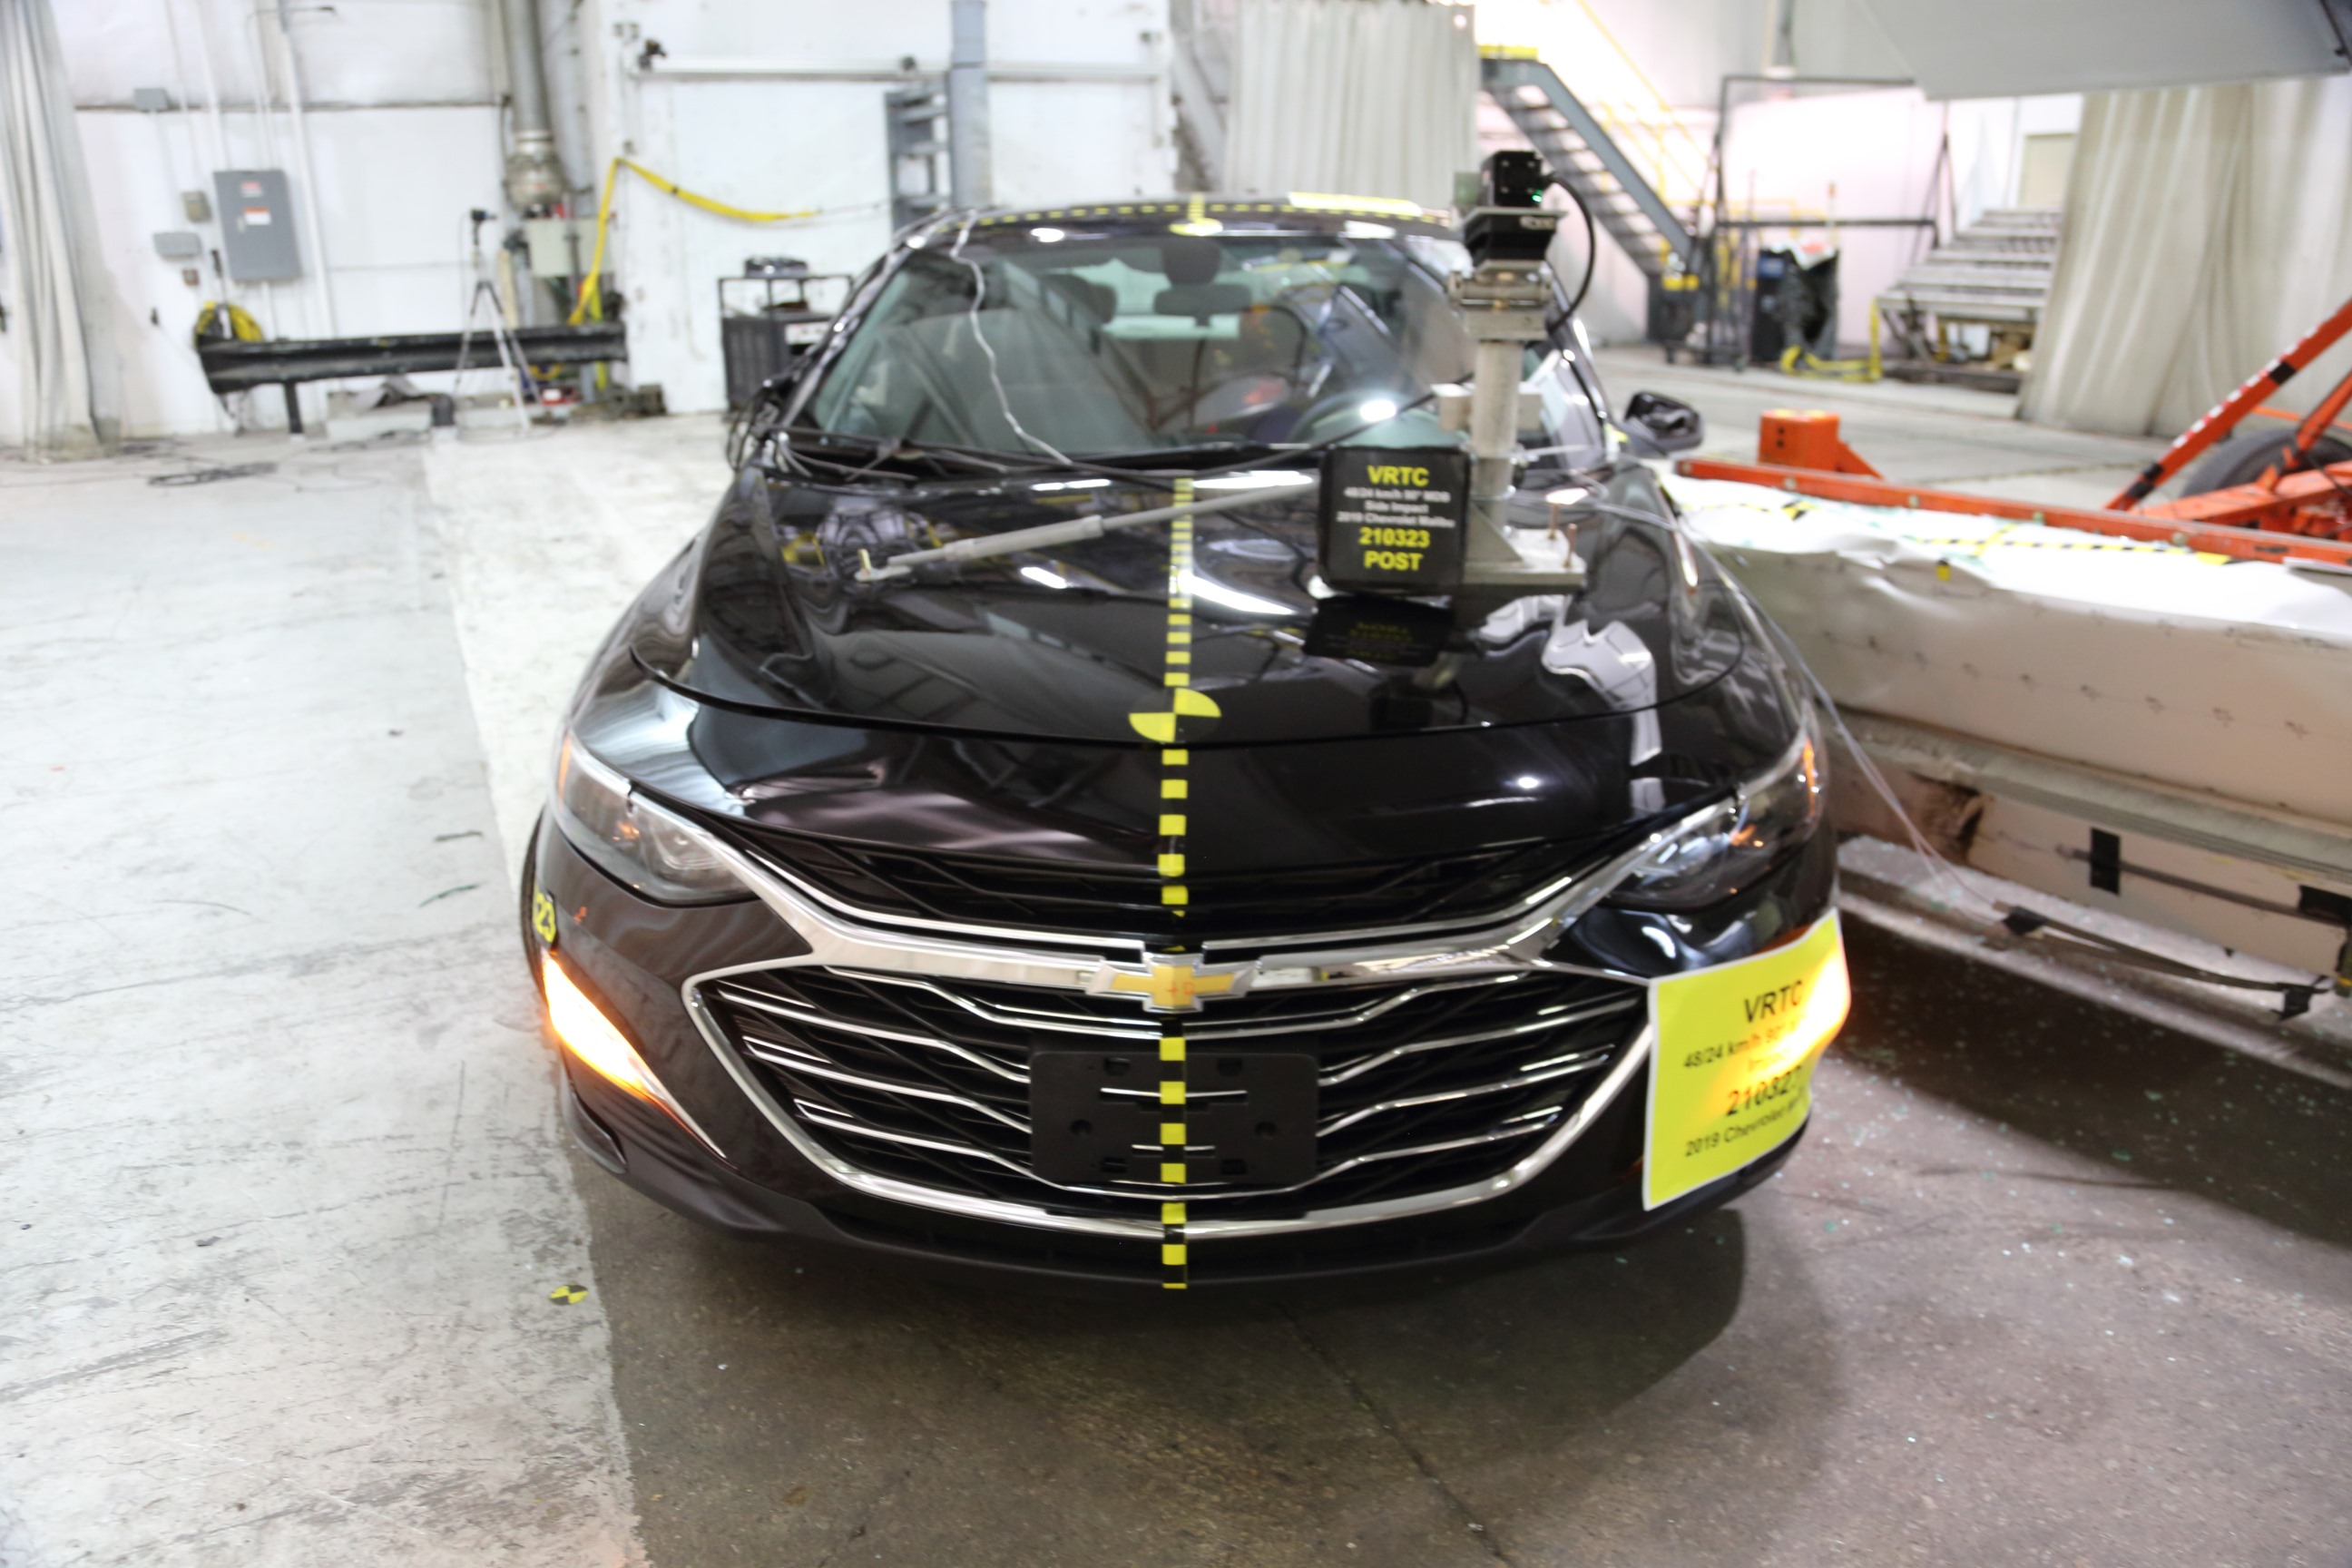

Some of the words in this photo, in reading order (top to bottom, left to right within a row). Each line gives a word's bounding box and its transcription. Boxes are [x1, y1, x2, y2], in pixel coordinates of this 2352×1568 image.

[1367, 466, 1430, 485] VRTC
[1358, 527, 1431, 548] 210323
[1364, 551, 1423, 571] POST
[1744, 980, 1802, 1022] VRTC
[1684, 1045, 1722, 1068] 48/24
[1686, 1133, 1719, 1157] 2019
